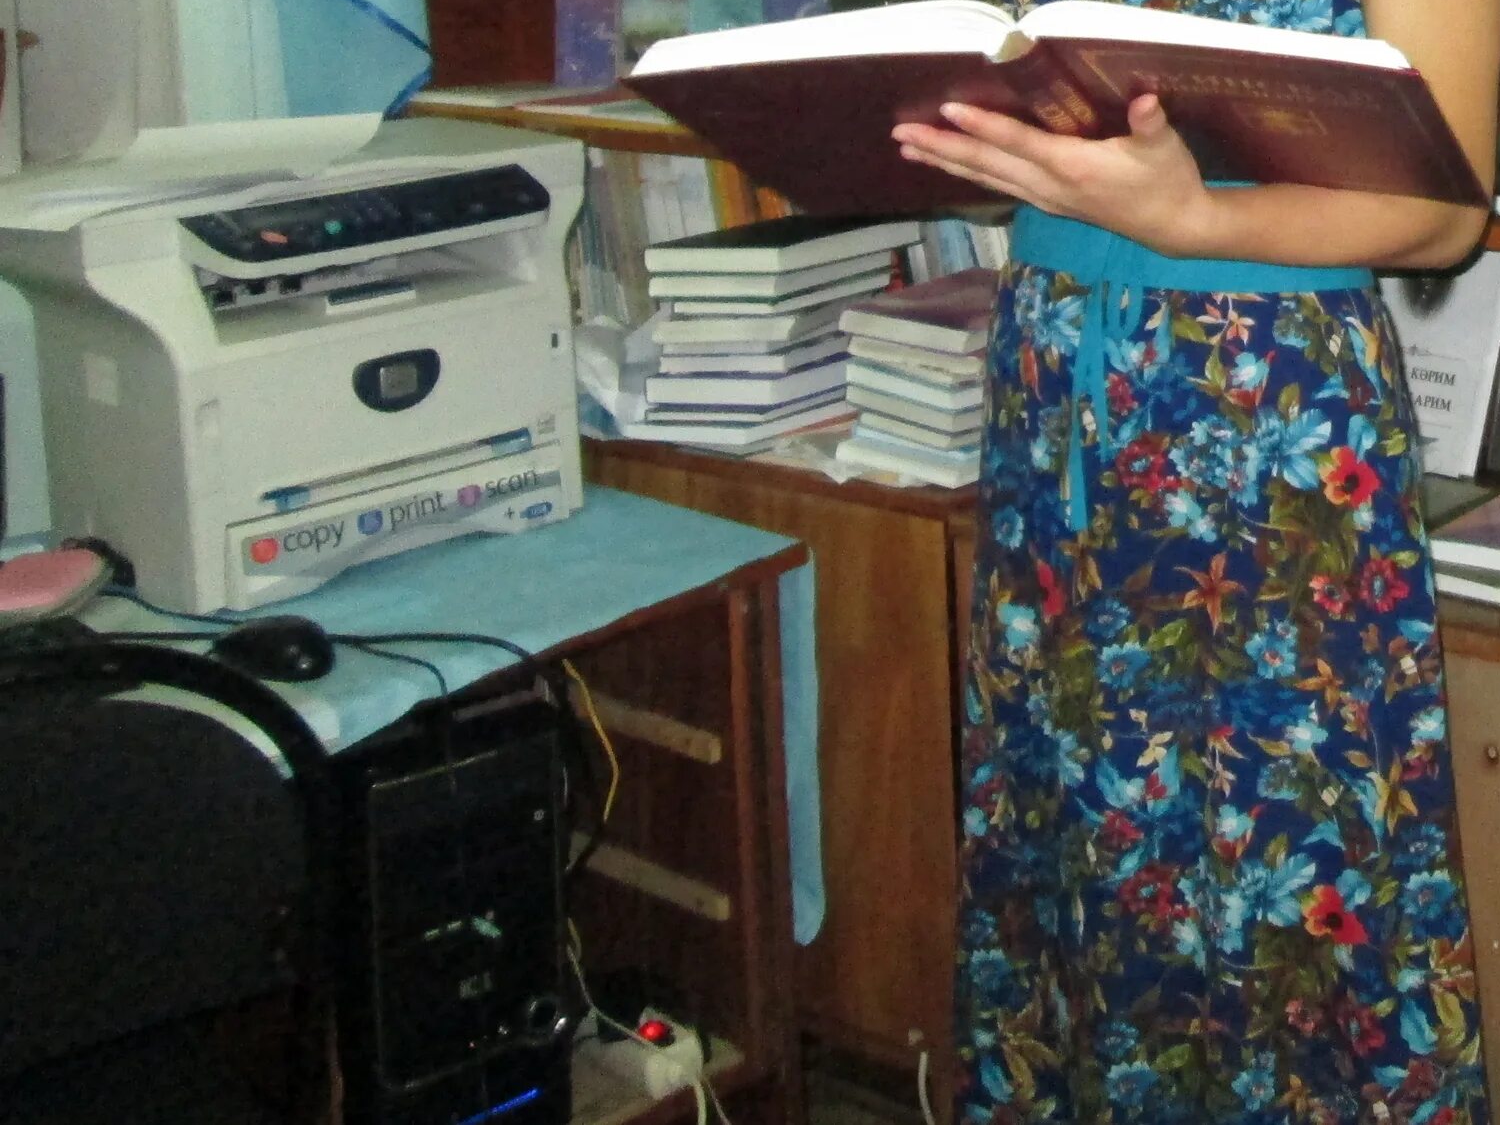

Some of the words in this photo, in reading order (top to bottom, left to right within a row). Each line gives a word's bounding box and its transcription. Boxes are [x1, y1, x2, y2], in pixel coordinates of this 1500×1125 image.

[1411, 367, 1457, 386] КӘРИМ
[1414, 394, 1452, 412] АРИМ
[283, 521, 345, 553] copy
[390, 490, 446, 532] print
[485, 468, 538, 498] scan
